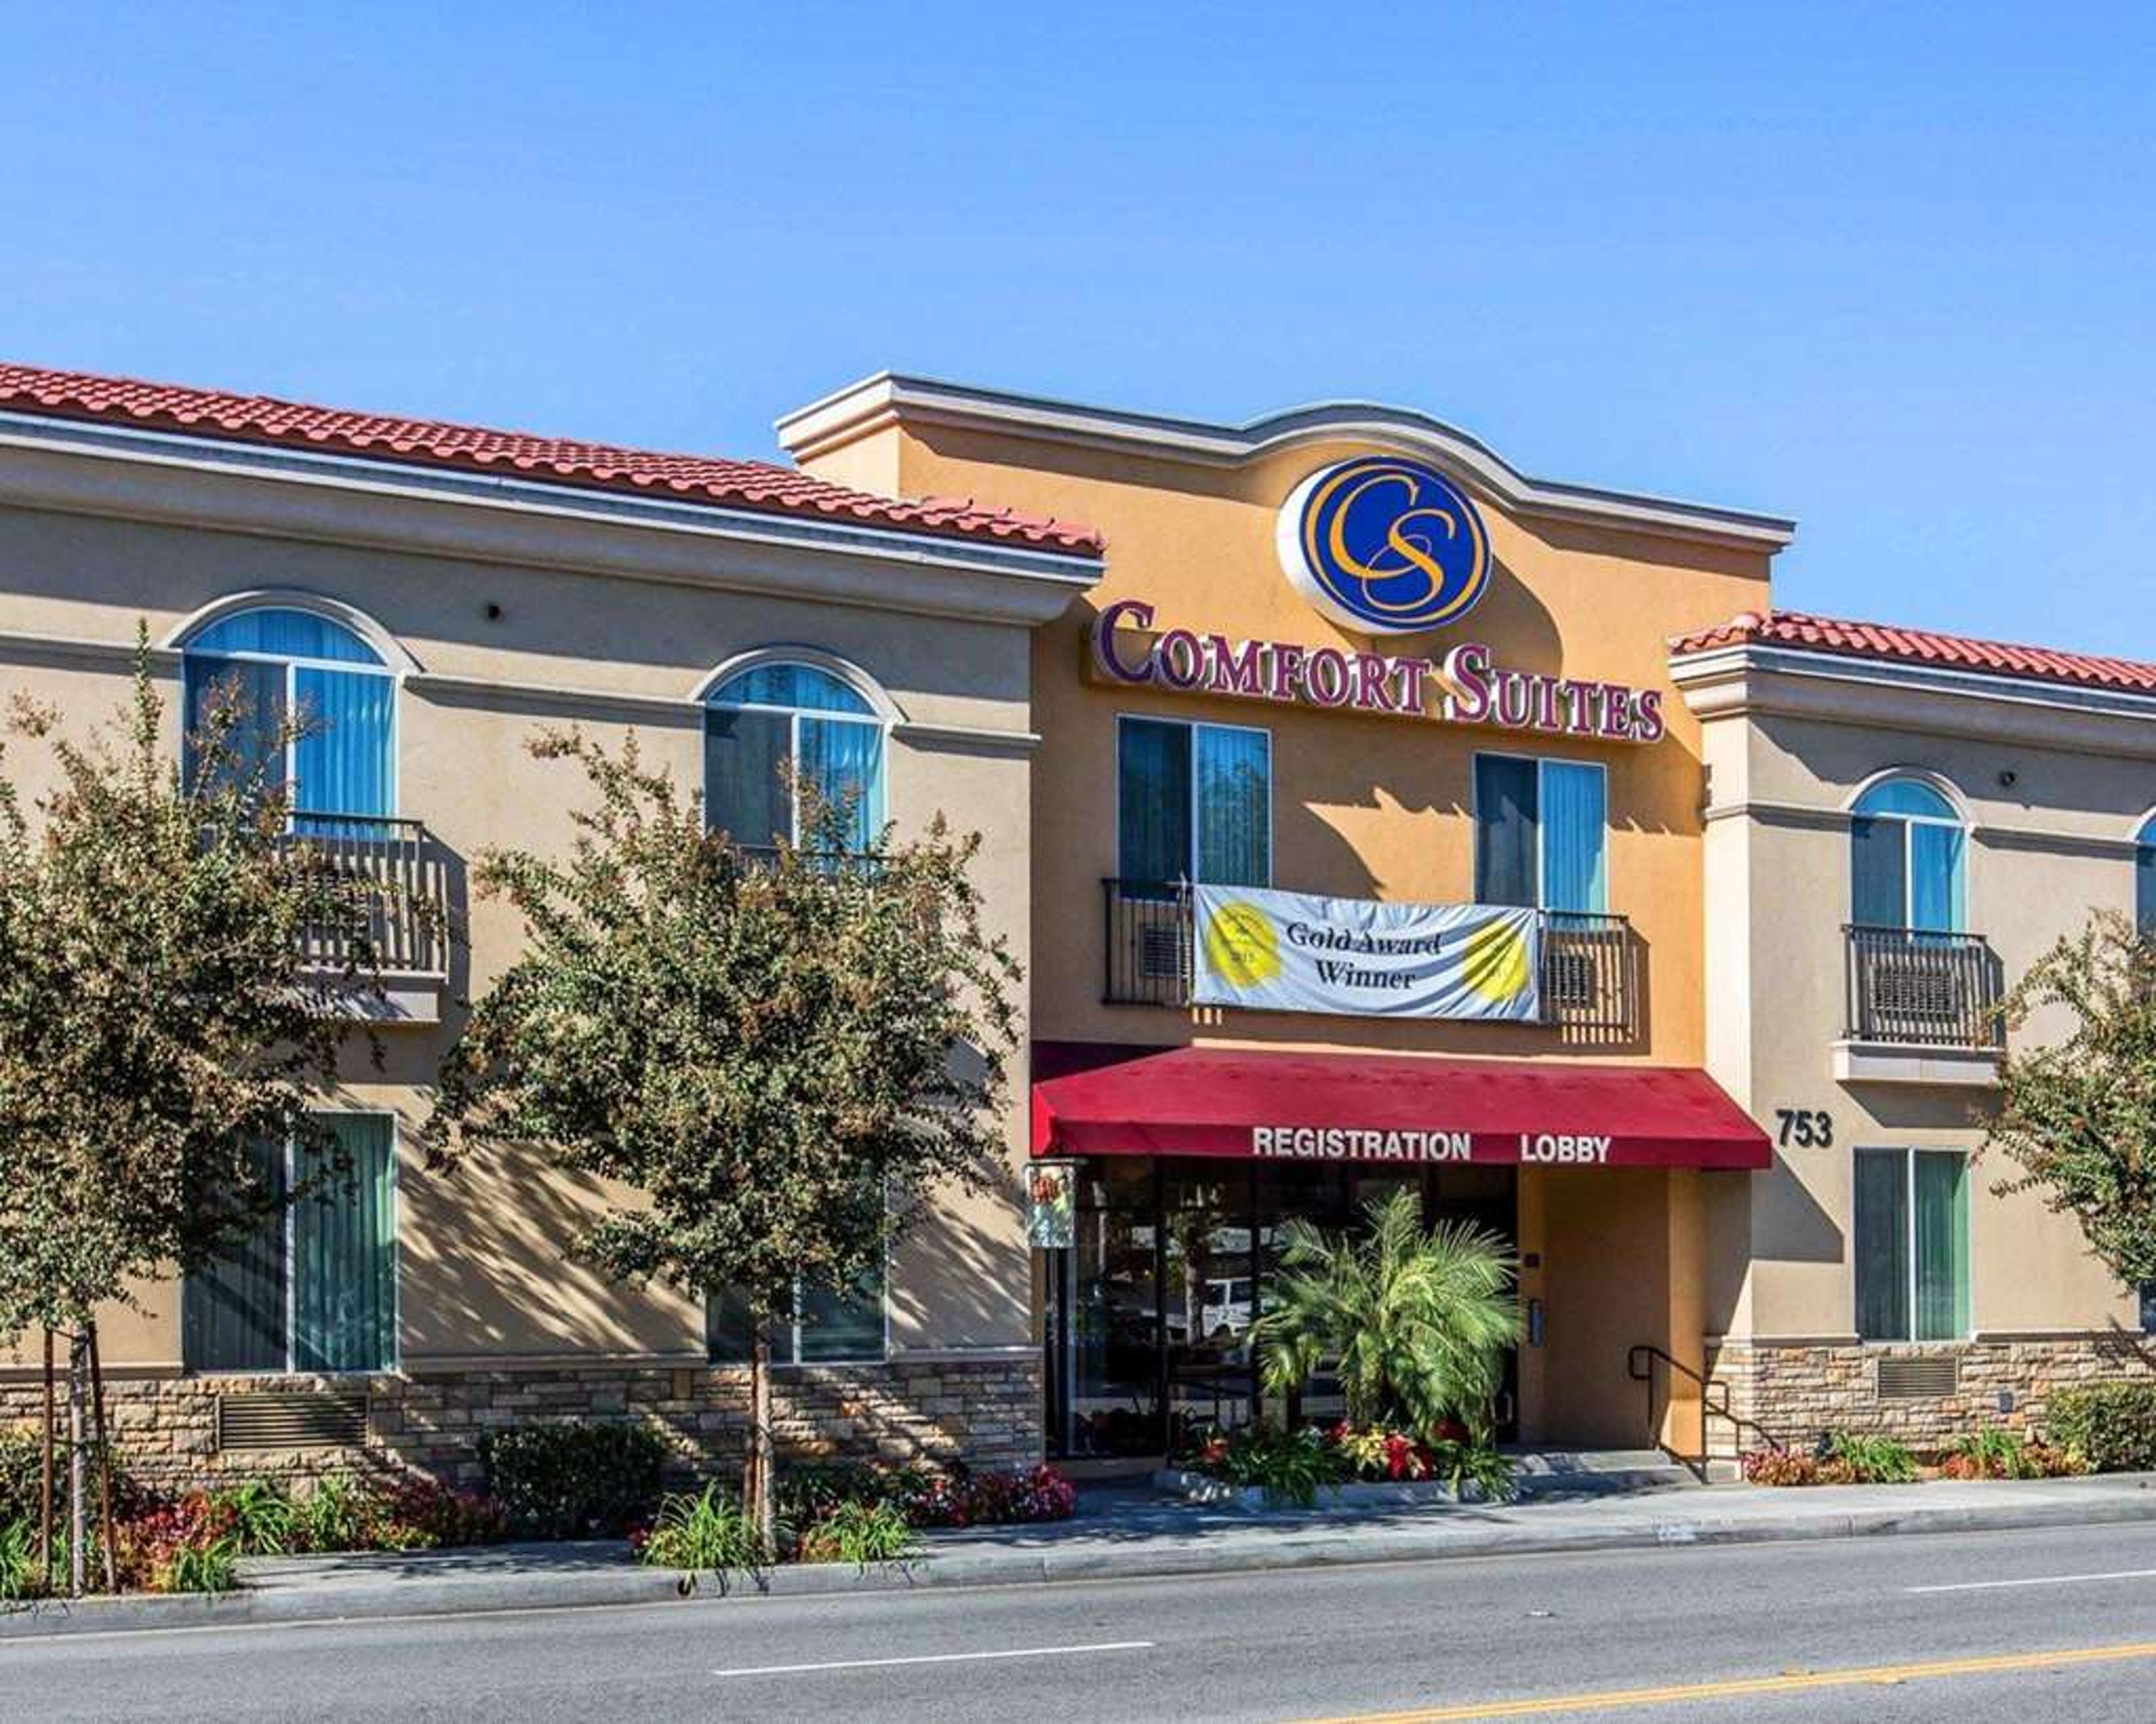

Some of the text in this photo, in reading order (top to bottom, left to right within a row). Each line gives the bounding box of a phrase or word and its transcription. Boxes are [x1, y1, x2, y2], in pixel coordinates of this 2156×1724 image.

[1093, 600, 1665, 742] COMFORT SUITES
[1287, 922, 1351, 950] Gold
[1358, 932, 1441, 955] Award
[1315, 960, 1416, 990] Winner
[1253, 1127, 1611, 1163] REGISTRATION LOBBY
[1776, 1110, 1833, 1148] 753
